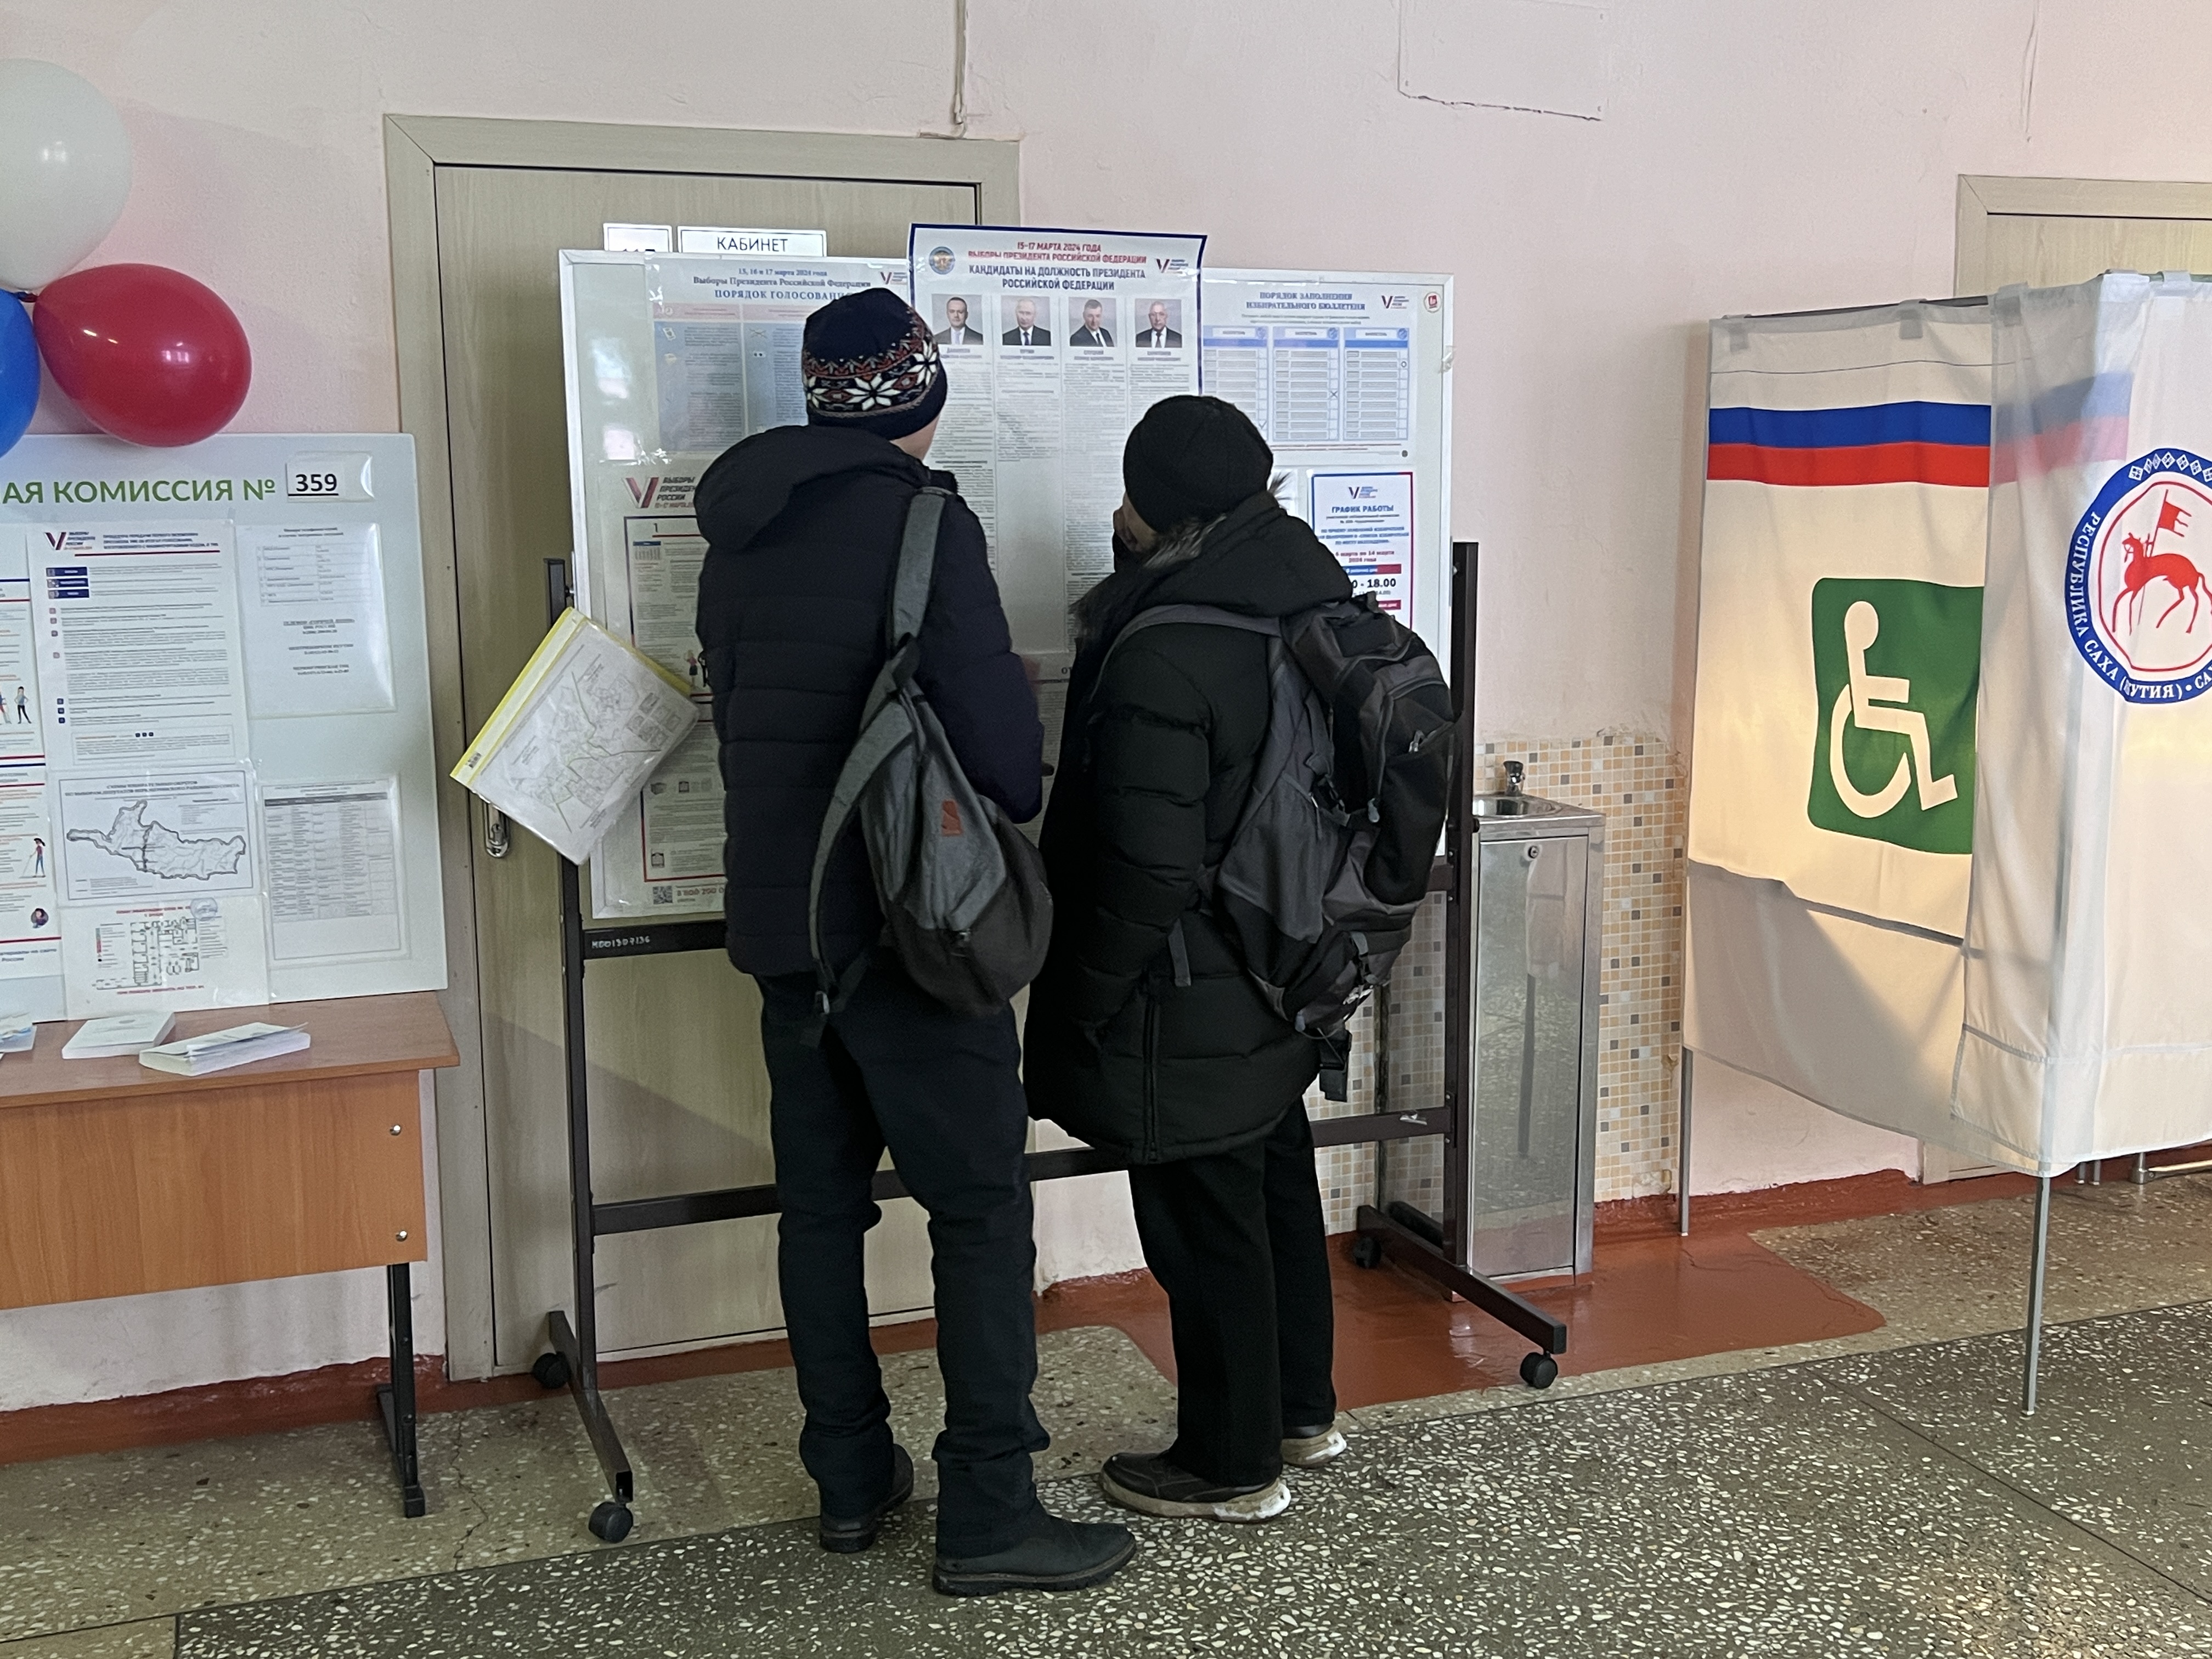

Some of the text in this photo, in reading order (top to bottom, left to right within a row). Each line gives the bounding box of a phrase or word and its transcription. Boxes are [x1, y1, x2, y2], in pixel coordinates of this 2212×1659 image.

[717, 236, 788, 252] КАБИНЕТ
[1036, 242, 1062, 251] МАРТА
[1063, 243, 1081, 251] 2024
[1003, 251, 1051, 261] ПРЕЗИДЕНТА
[1052, 252, 1101, 262] РОССИЙСКОЙ
[1102, 255, 1147, 263] ФЕДЕРАЦИИ
[969, 265, 1146, 279] КАНДИДАТЫ НА ДОЛЖНОСТЬ ПРЕЗИДЕНТА
[693, 276, 727, 285] Выборы
[730, 277, 777, 286] Президента
[827, 279, 871, 290] Федерации
[1002, 276, 1115, 291] РОССИЙСКОЙ ФЕДЕРАЦИИ
[714, 290, 768, 300] ПОРЯДОК
[1246, 302, 1365, 311] ИЗБИРАТЕЛЬНОГО БЮЛЛЕТЕНЯ
[55, 479, 234, 503] КОМИССИЯ
[296, 473, 337, 492] 359
[653, 522, 658, 533] 1
[2069, 511, 2101, 637] РЕСПУБЛИКА
[1367, 578, 1397, 589] 18.00
[2084, 639, 2120, 681] САХА
[2194, 664, 2212, 690] СА
[2119, 675, 2183, 701] (УТИЯ)
